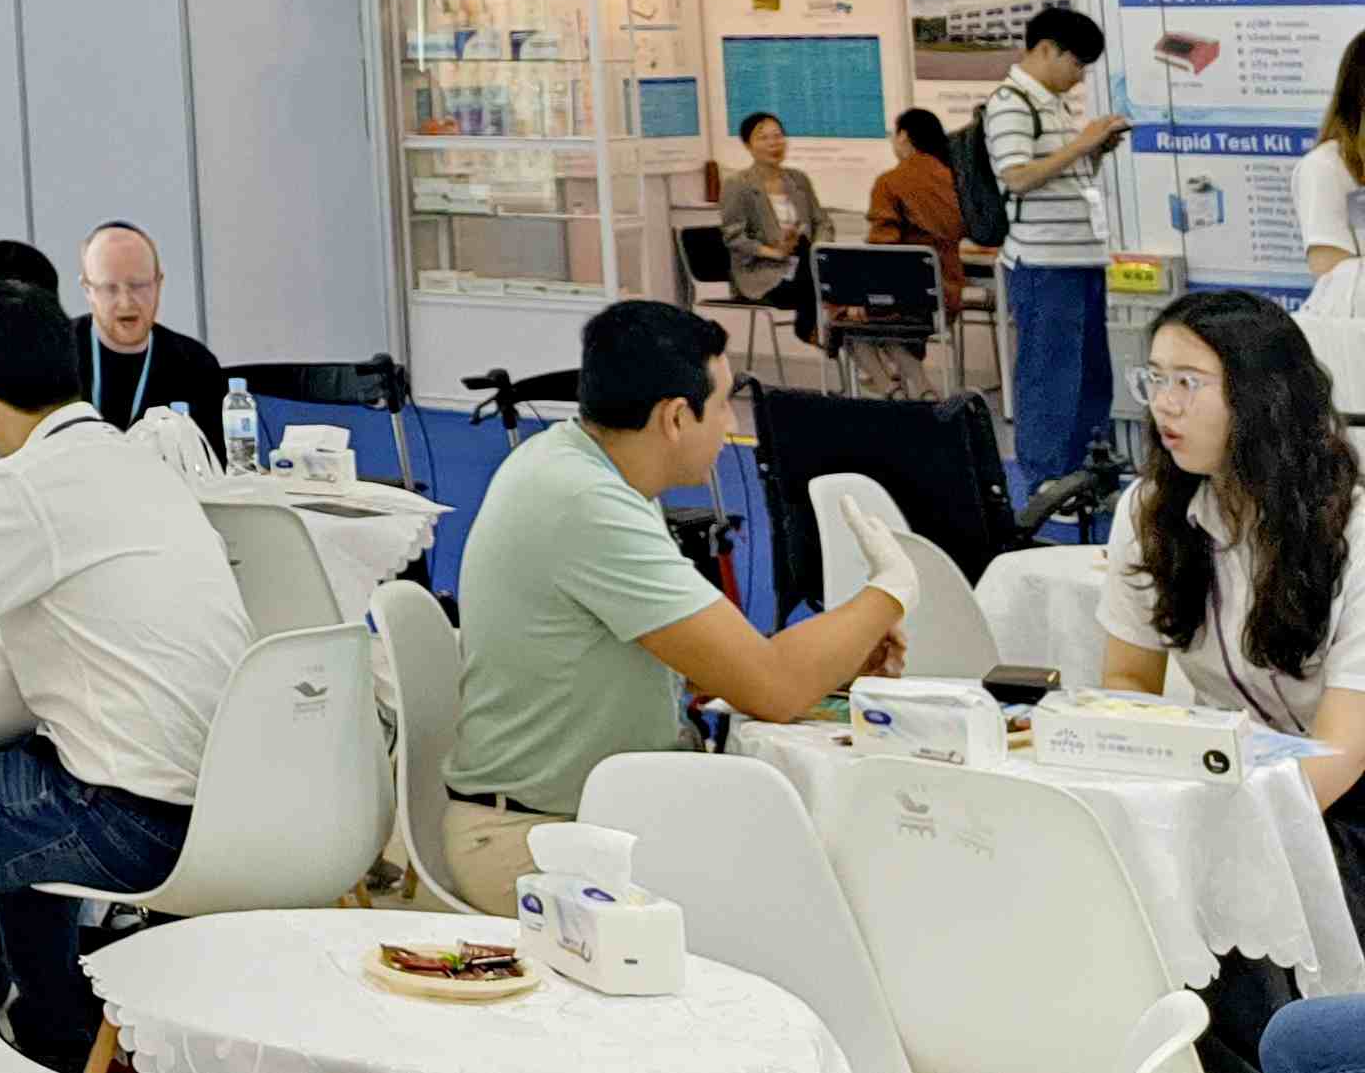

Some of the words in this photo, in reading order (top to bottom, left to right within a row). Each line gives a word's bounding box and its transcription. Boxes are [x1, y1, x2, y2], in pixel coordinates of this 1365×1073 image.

[1157, 131, 1211, 153] Rapid
[1215, 132, 1259, 153] Test
[1264, 133, 1292, 153] Kit
